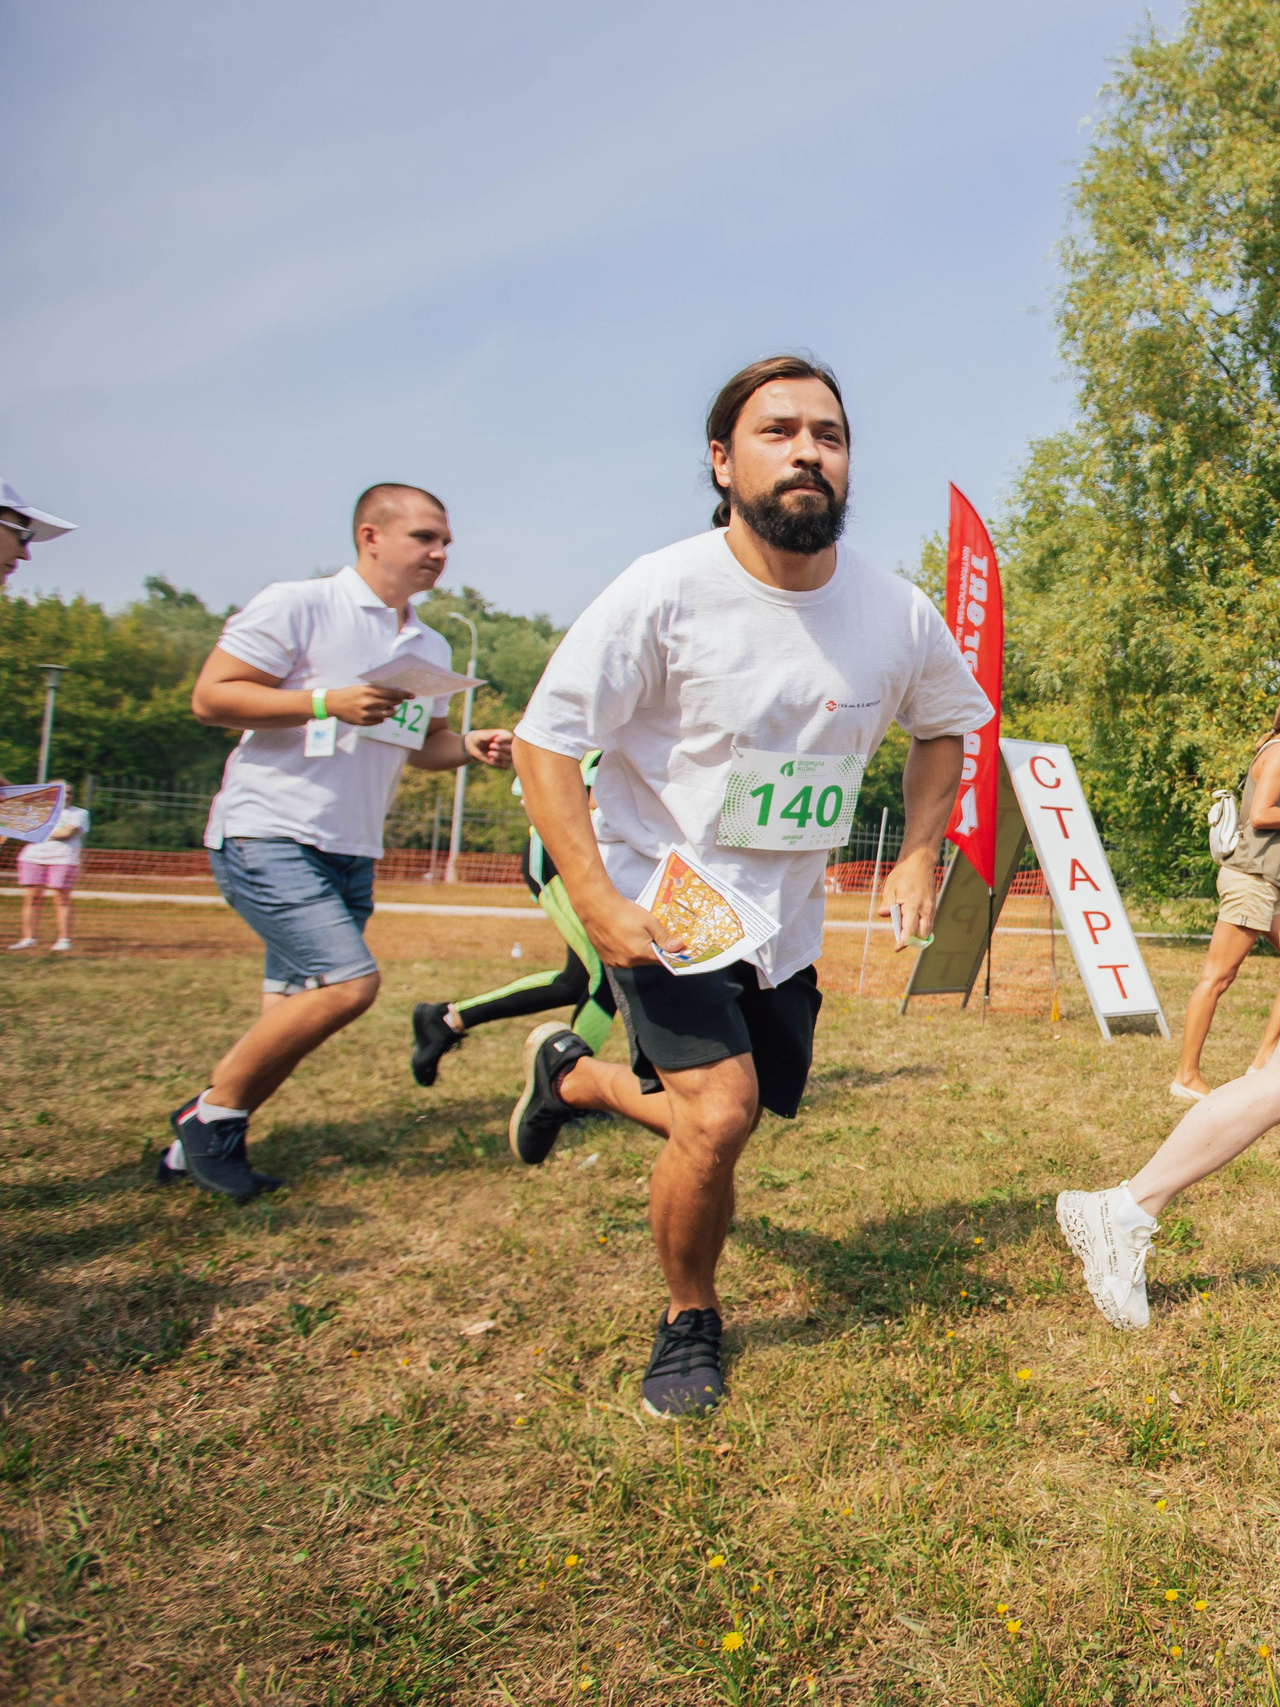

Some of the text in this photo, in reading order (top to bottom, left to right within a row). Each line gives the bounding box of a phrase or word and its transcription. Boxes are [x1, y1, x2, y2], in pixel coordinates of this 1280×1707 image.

[391, 701, 423, 733] 42
[749, 783, 843, 828] 140
[1029, 756, 1129, 999] СТАРТ
